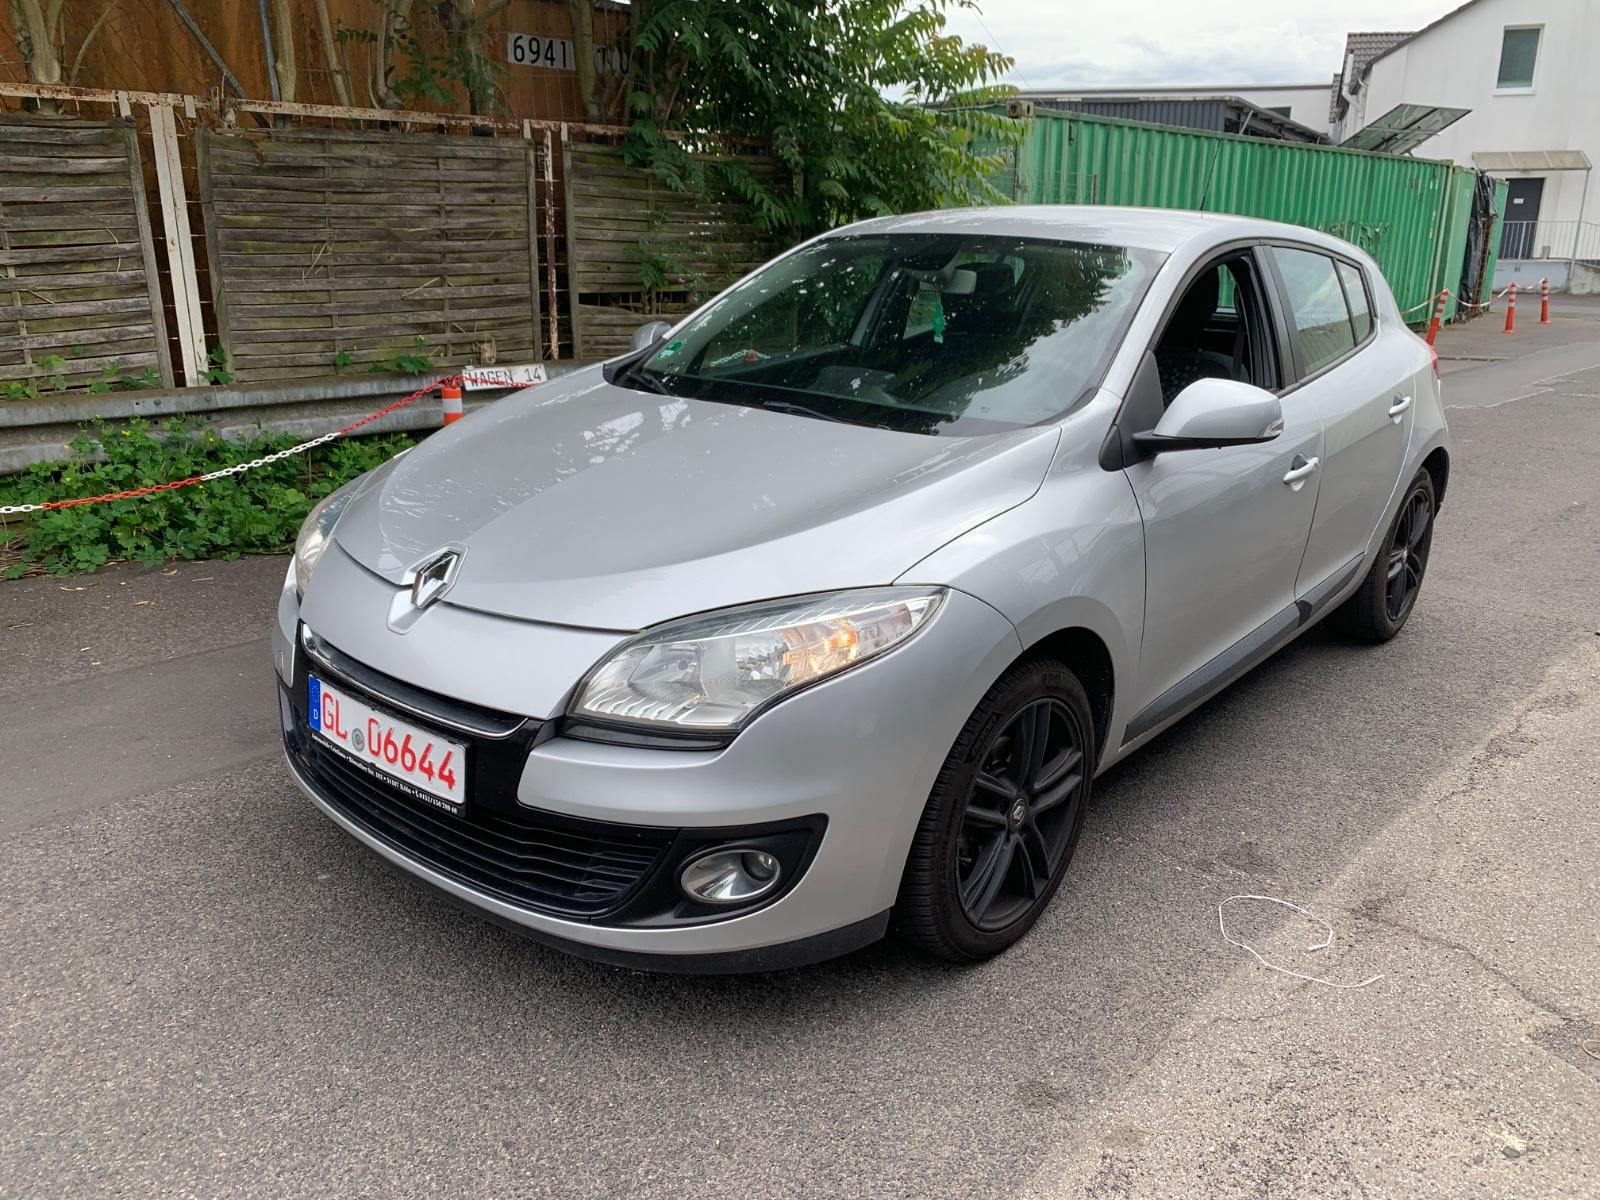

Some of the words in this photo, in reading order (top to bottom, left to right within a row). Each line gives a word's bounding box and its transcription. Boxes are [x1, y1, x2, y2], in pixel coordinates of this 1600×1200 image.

[512, 35, 567, 69] 6941
[467, 369, 514, 387] WAGEN
[524, 366, 542, 383] 14
[313, 708, 319, 720] D
[322, 691, 348, 740] GL
[367, 717, 456, 791] 06644
